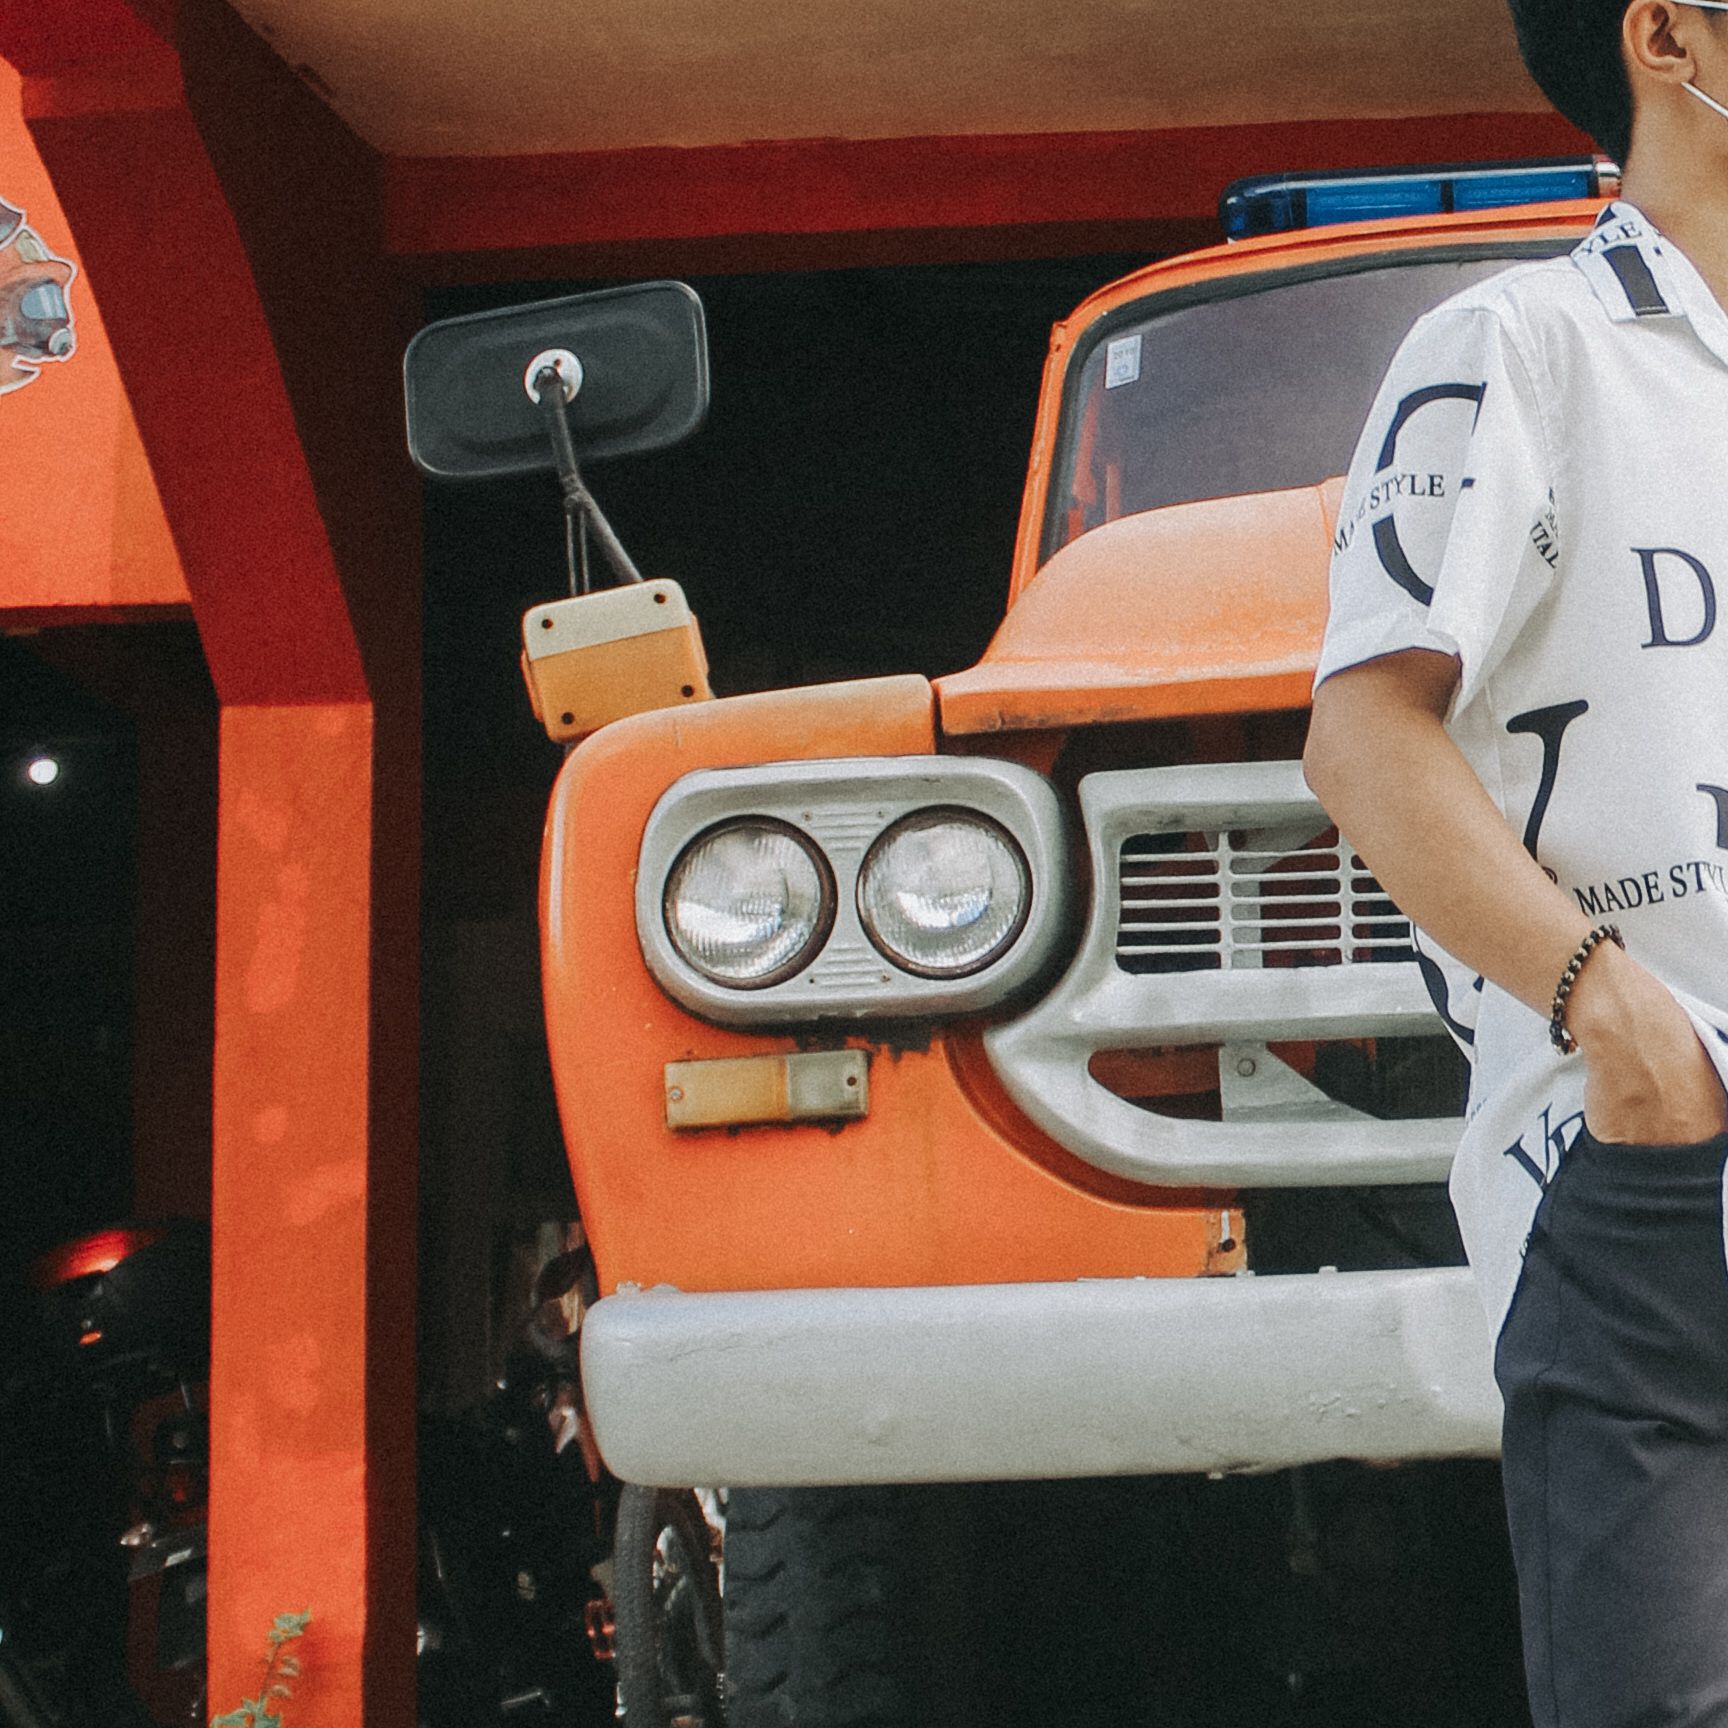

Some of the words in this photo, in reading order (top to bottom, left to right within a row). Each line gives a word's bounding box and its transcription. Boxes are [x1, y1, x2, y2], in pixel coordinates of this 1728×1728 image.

[1369, 474, 1445, 511] STYLE
[1630, 546, 1717, 649] D
[1573, 871, 1664, 917] MADE
